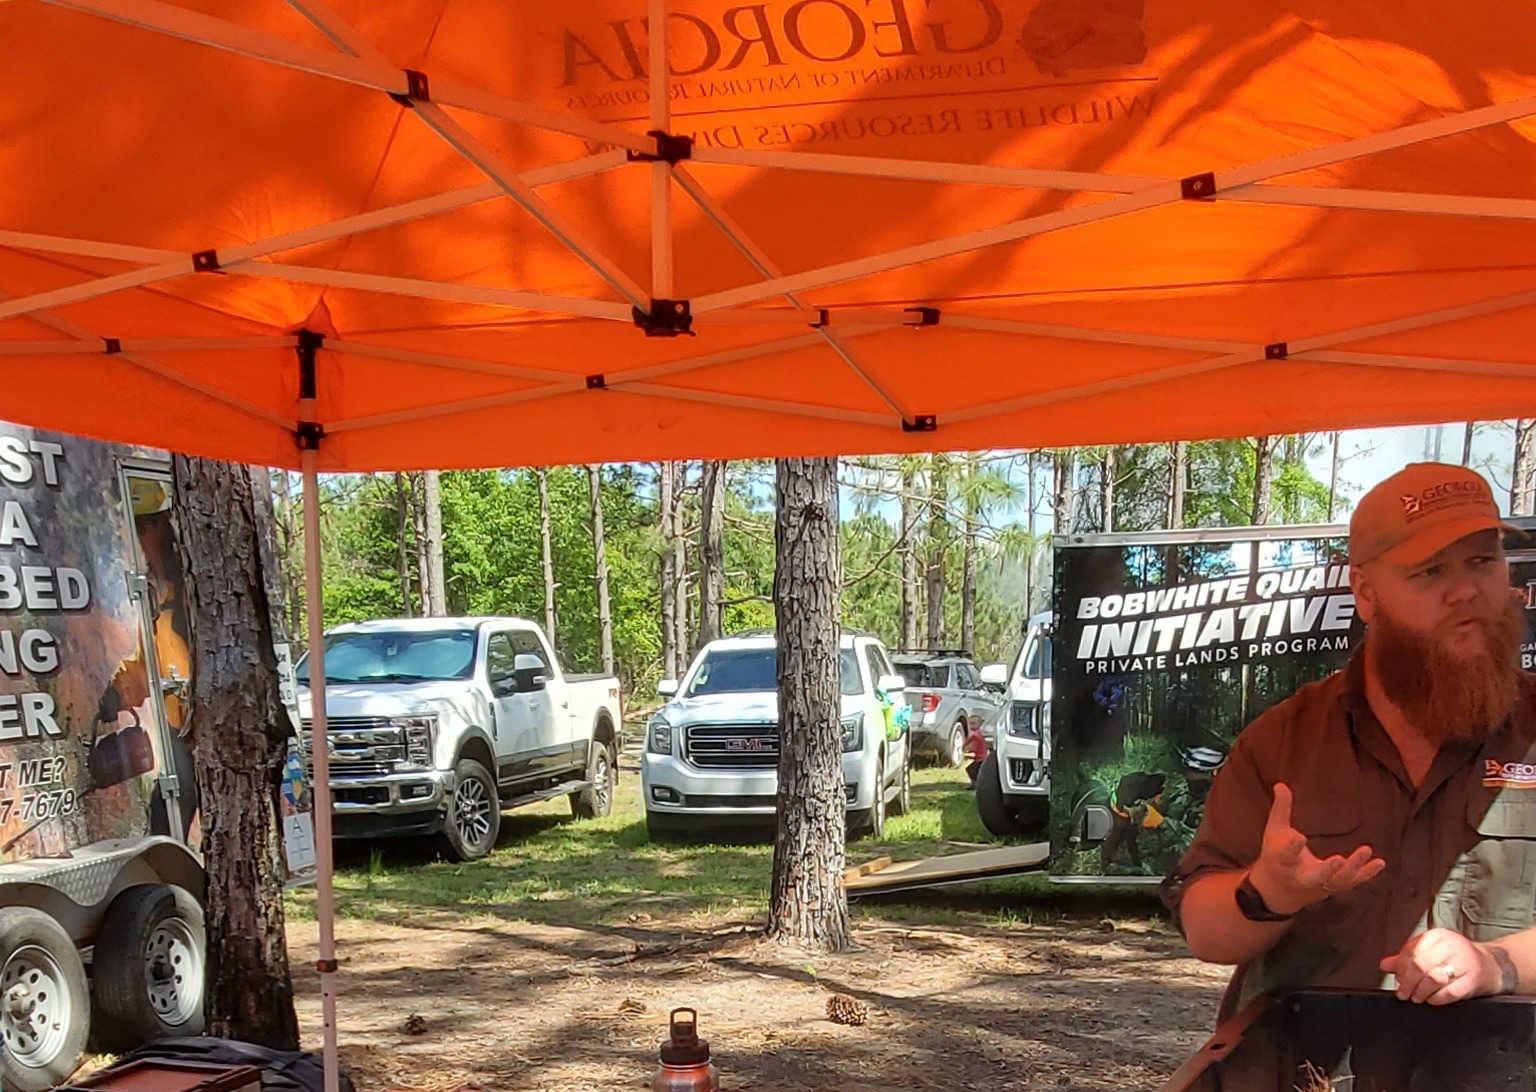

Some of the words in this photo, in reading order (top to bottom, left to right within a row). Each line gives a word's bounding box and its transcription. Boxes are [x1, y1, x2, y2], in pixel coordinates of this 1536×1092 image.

[1076, 576, 1250, 620] BOBWHITE
[1075, 593, 1357, 660] INITIATIVE
[1085, 656, 1167, 675] PRIVATE
[1174, 646, 1240, 668] LANDS
[1248, 634, 1350, 659] PROGRAM
[725, 738, 773, 751] GMC
[17, 756, 66, 787] ME?
